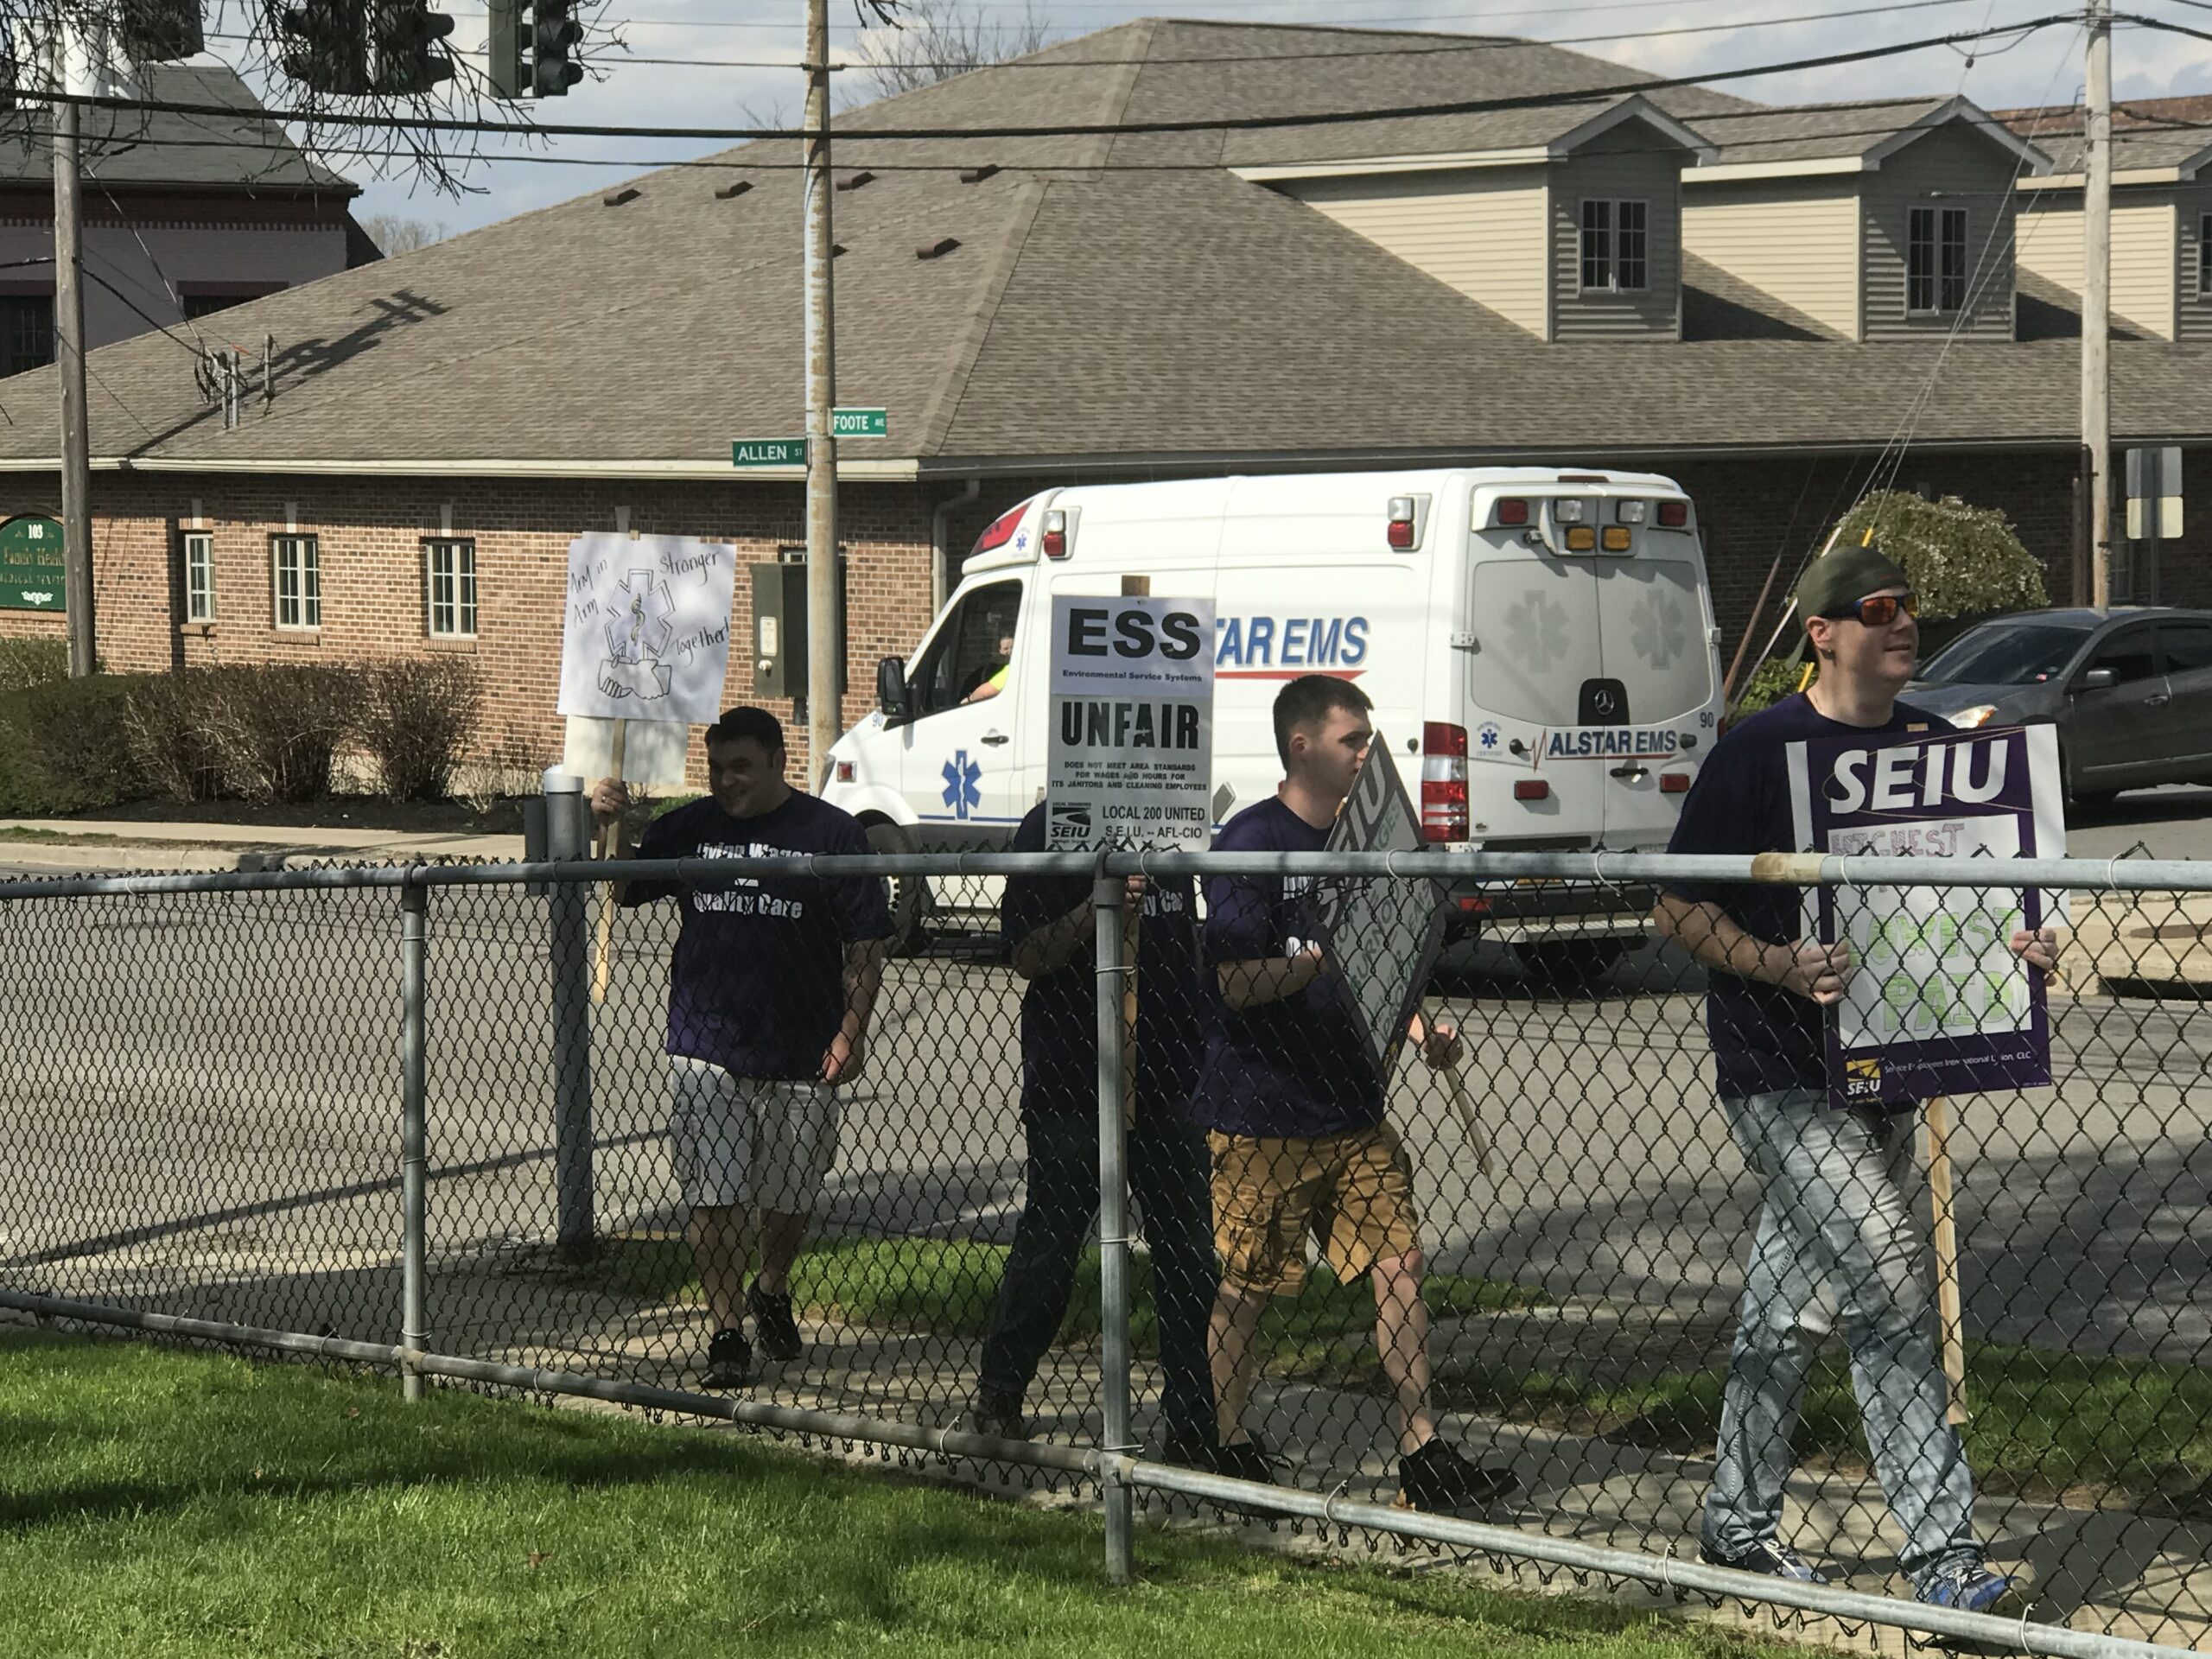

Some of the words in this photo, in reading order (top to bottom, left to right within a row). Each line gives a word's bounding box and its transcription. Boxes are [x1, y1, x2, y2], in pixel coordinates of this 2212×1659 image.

[834, 416, 869, 430] FOOTE
[874, 418, 885, 427] AVE
[738, 446, 787, 461] ALLEN
[795, 448, 803, 456] ST
[28, 524, 44, 539] 103
[596, 559, 608, 575] in
[659, 551, 720, 587] Stronger
[573, 598, 599, 626] Arm
[1068, 608, 1201, 661] ESS
[1281, 616, 1370, 665] EMS
[1063, 670, 1127, 679] Environmental
[1128, 672, 1162, 681] Service
[1165, 673, 1203, 683] Systems
[1061, 702, 1199, 749] UNFAIR
[1700, 711, 1714, 728] 90
[1548, 730, 1633, 756] ALSTAR
[1636, 730, 1677, 753] EMS
[1830, 740, 2008, 814] SEIU
[1103, 805, 1141, 820] LOCAL
[1143, 806, 1162, 820] 200
[1165, 807, 1205, 821] UNITED
[1051, 826, 1091, 838] SEIU
[1157, 826, 1203, 838] AFL-CIO
[759, 893, 803, 919] Care
[2016, 1051, 2031, 1060] CLC
